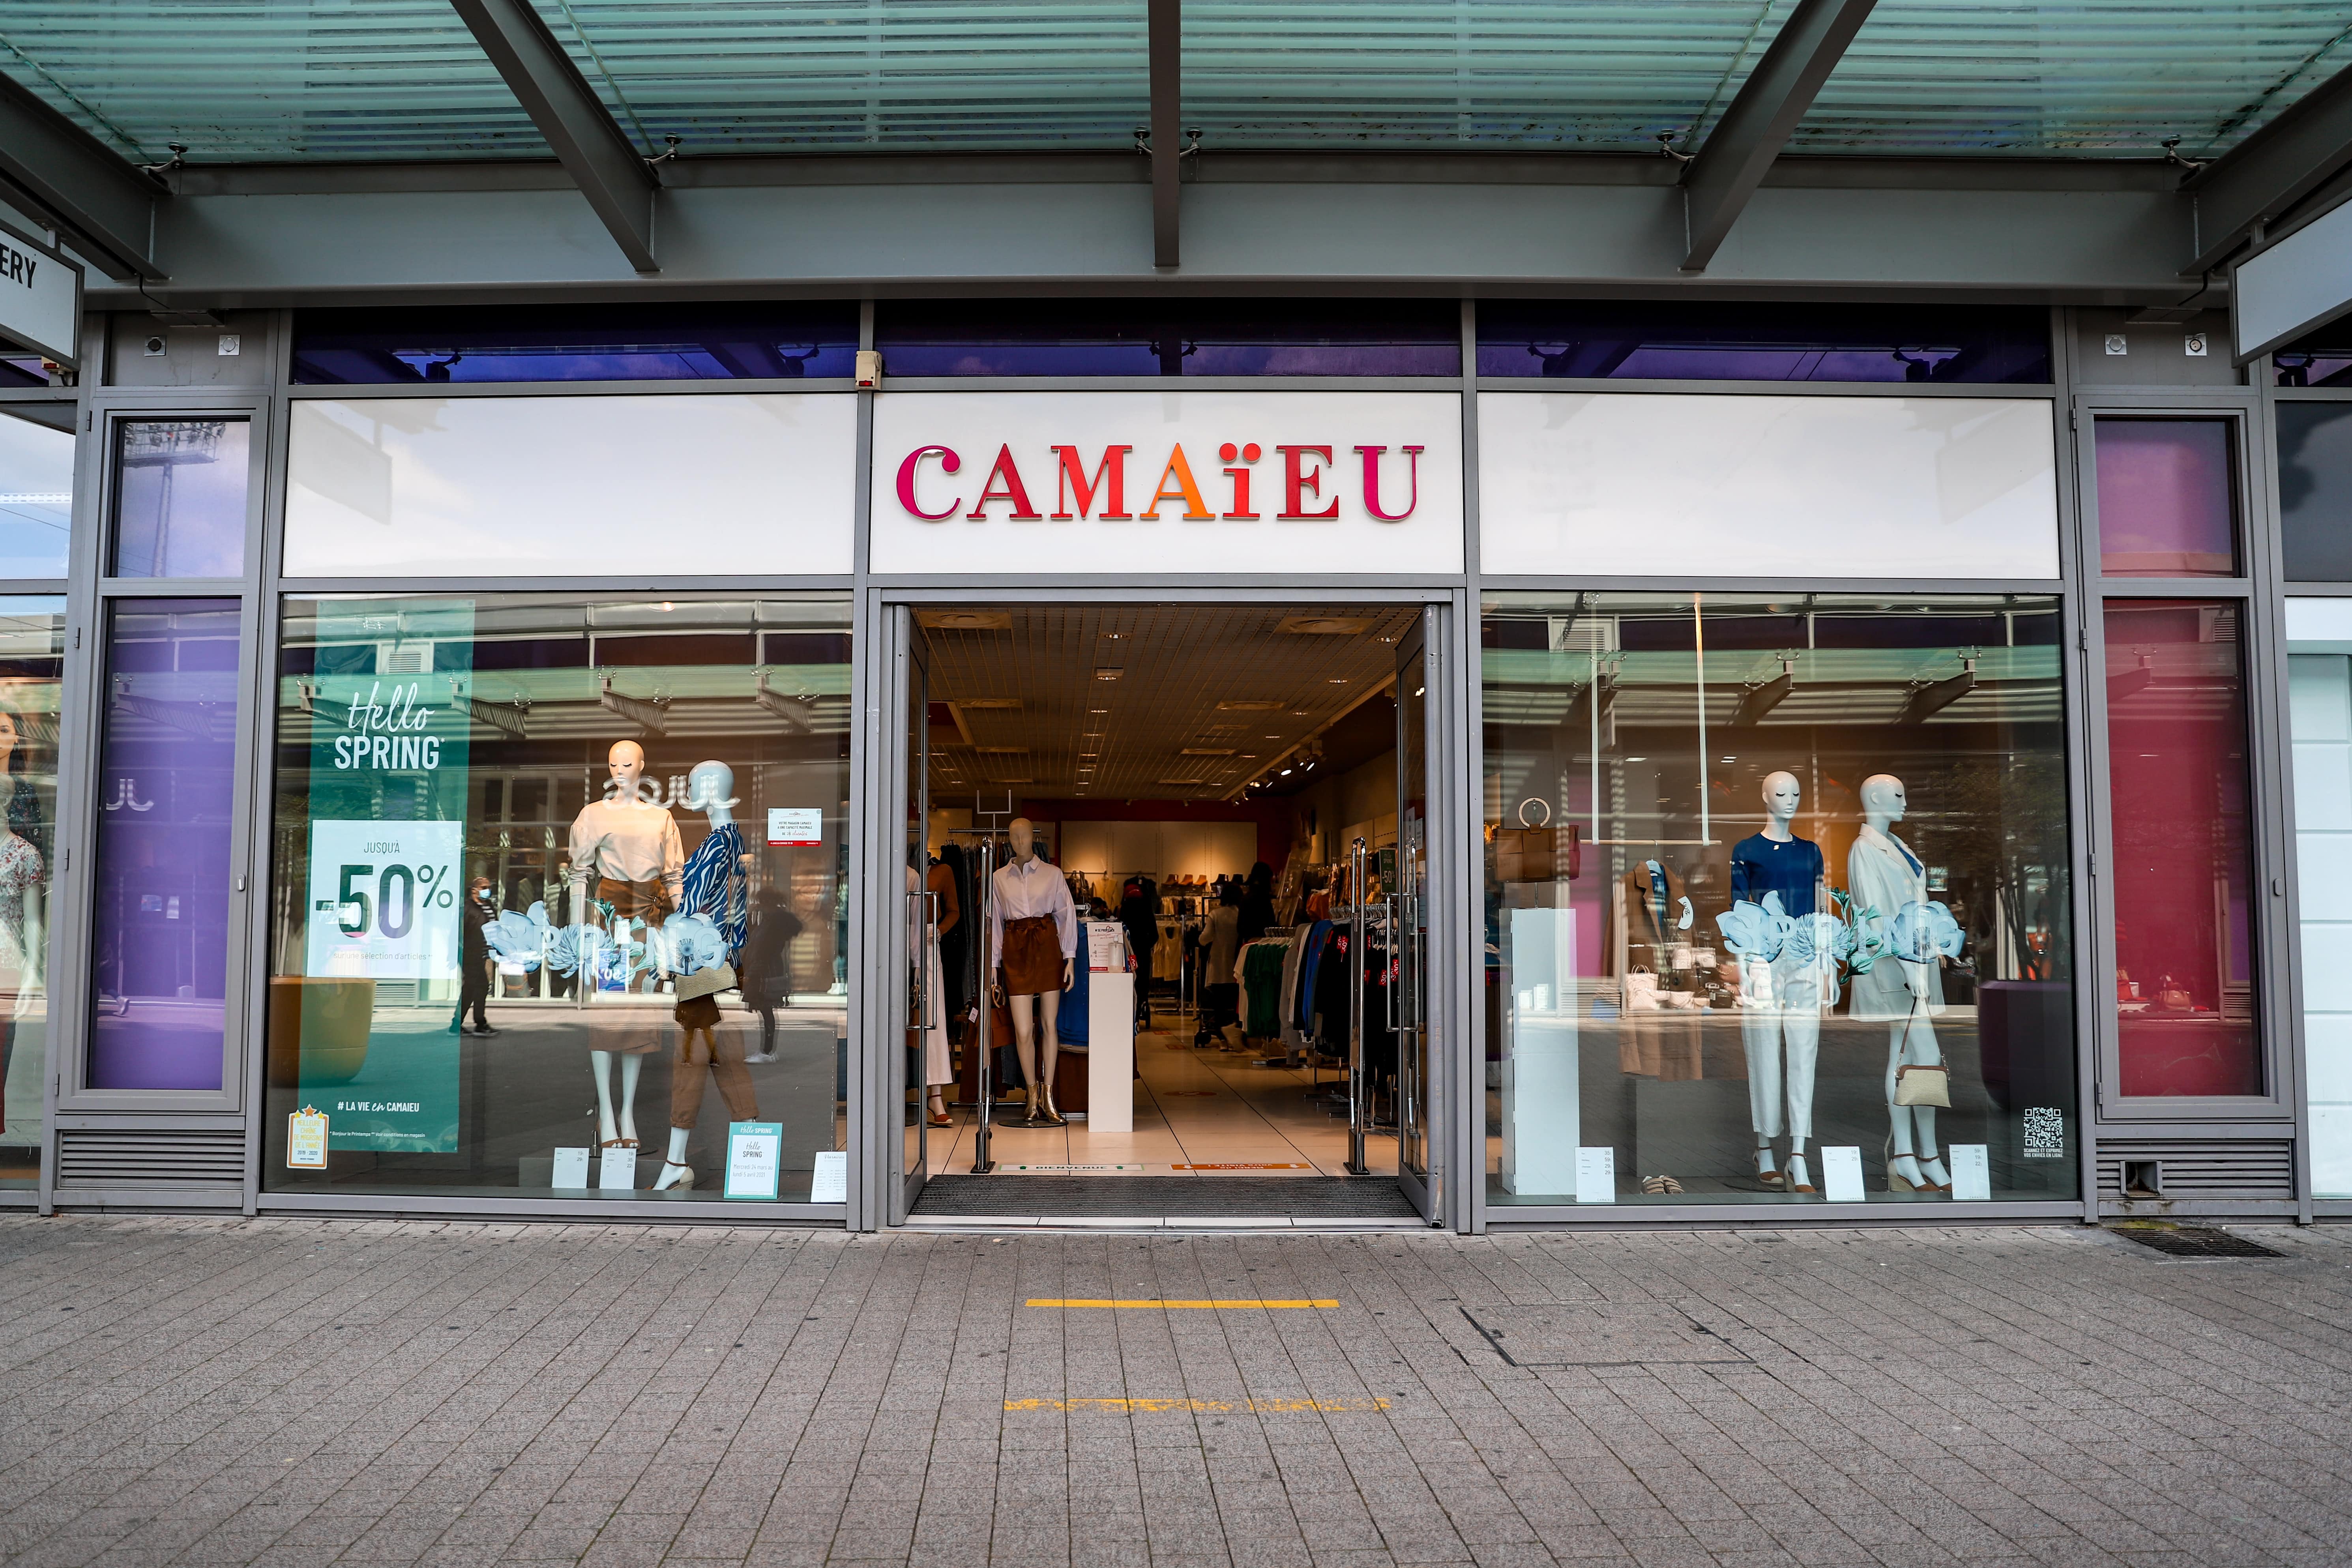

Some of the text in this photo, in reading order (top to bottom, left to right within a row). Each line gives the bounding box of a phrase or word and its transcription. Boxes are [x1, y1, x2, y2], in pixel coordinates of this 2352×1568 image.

[0, 242, 37, 289] ERY
[348, 681, 435, 736] Hello
[316, 864, 453, 939] -50%
[1724, 914, 1958, 954] SPRING
[346, 1102, 356, 1111] LA
[358, 1102, 370, 1111] VIE
[372, 1102, 385, 1112] en
[387, 1102, 419, 1112] CAMAIEU
[740, 1125, 755, 1133] Hello
[746, 1141, 761, 1150] Hello
